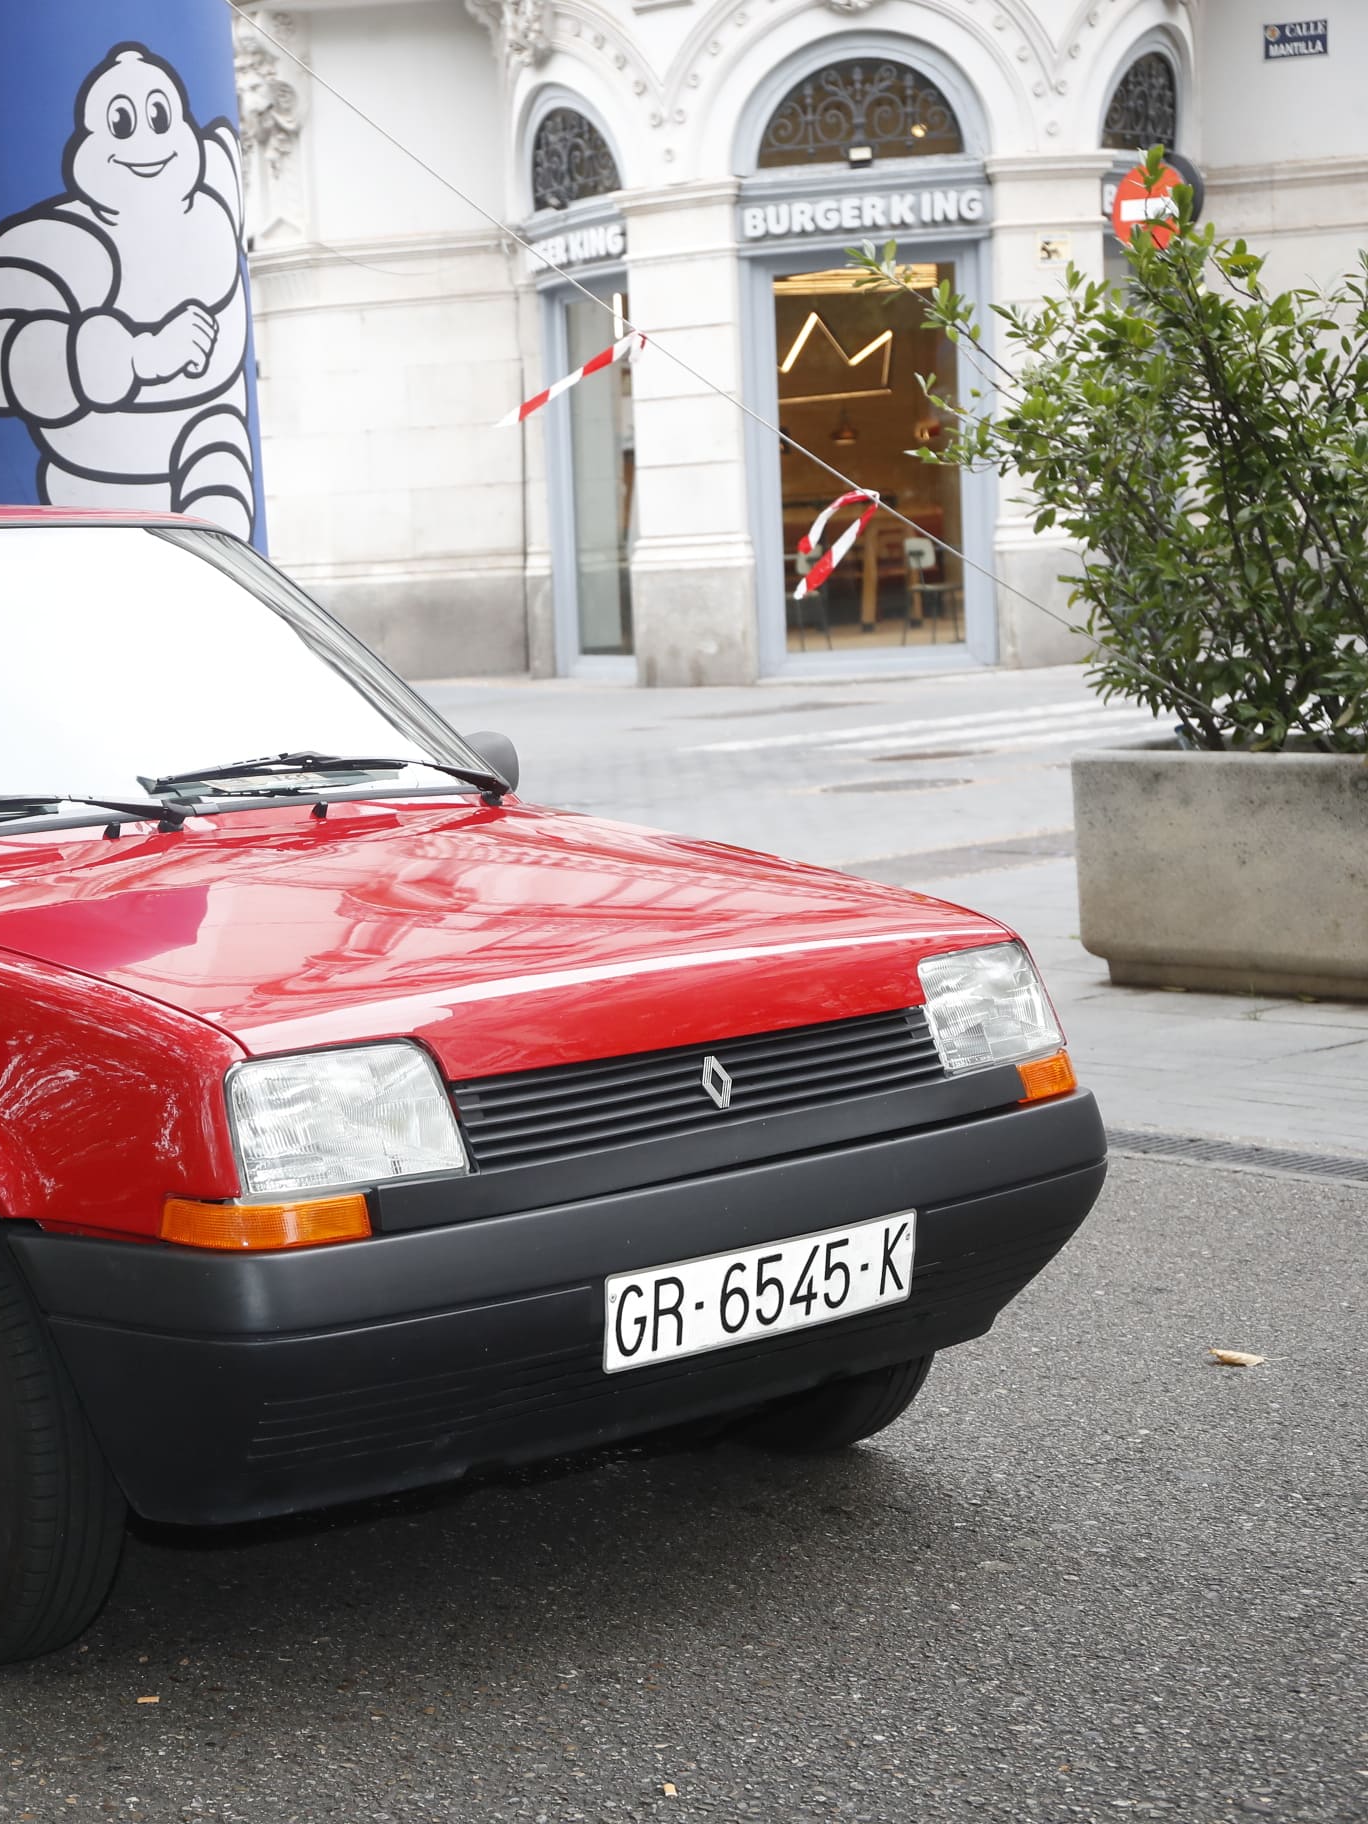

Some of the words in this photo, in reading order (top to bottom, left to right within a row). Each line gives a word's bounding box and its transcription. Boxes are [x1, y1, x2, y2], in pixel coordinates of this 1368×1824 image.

[1285, 20, 1327, 37] CALLE
[1269, 40, 1324, 57] MANTILLA
[743, 195, 887, 238] BURGER
[889, 189, 984, 225] KING
[568, 224, 625, 261] KING
[616, 1222, 908, 1357] GR-6545-K
